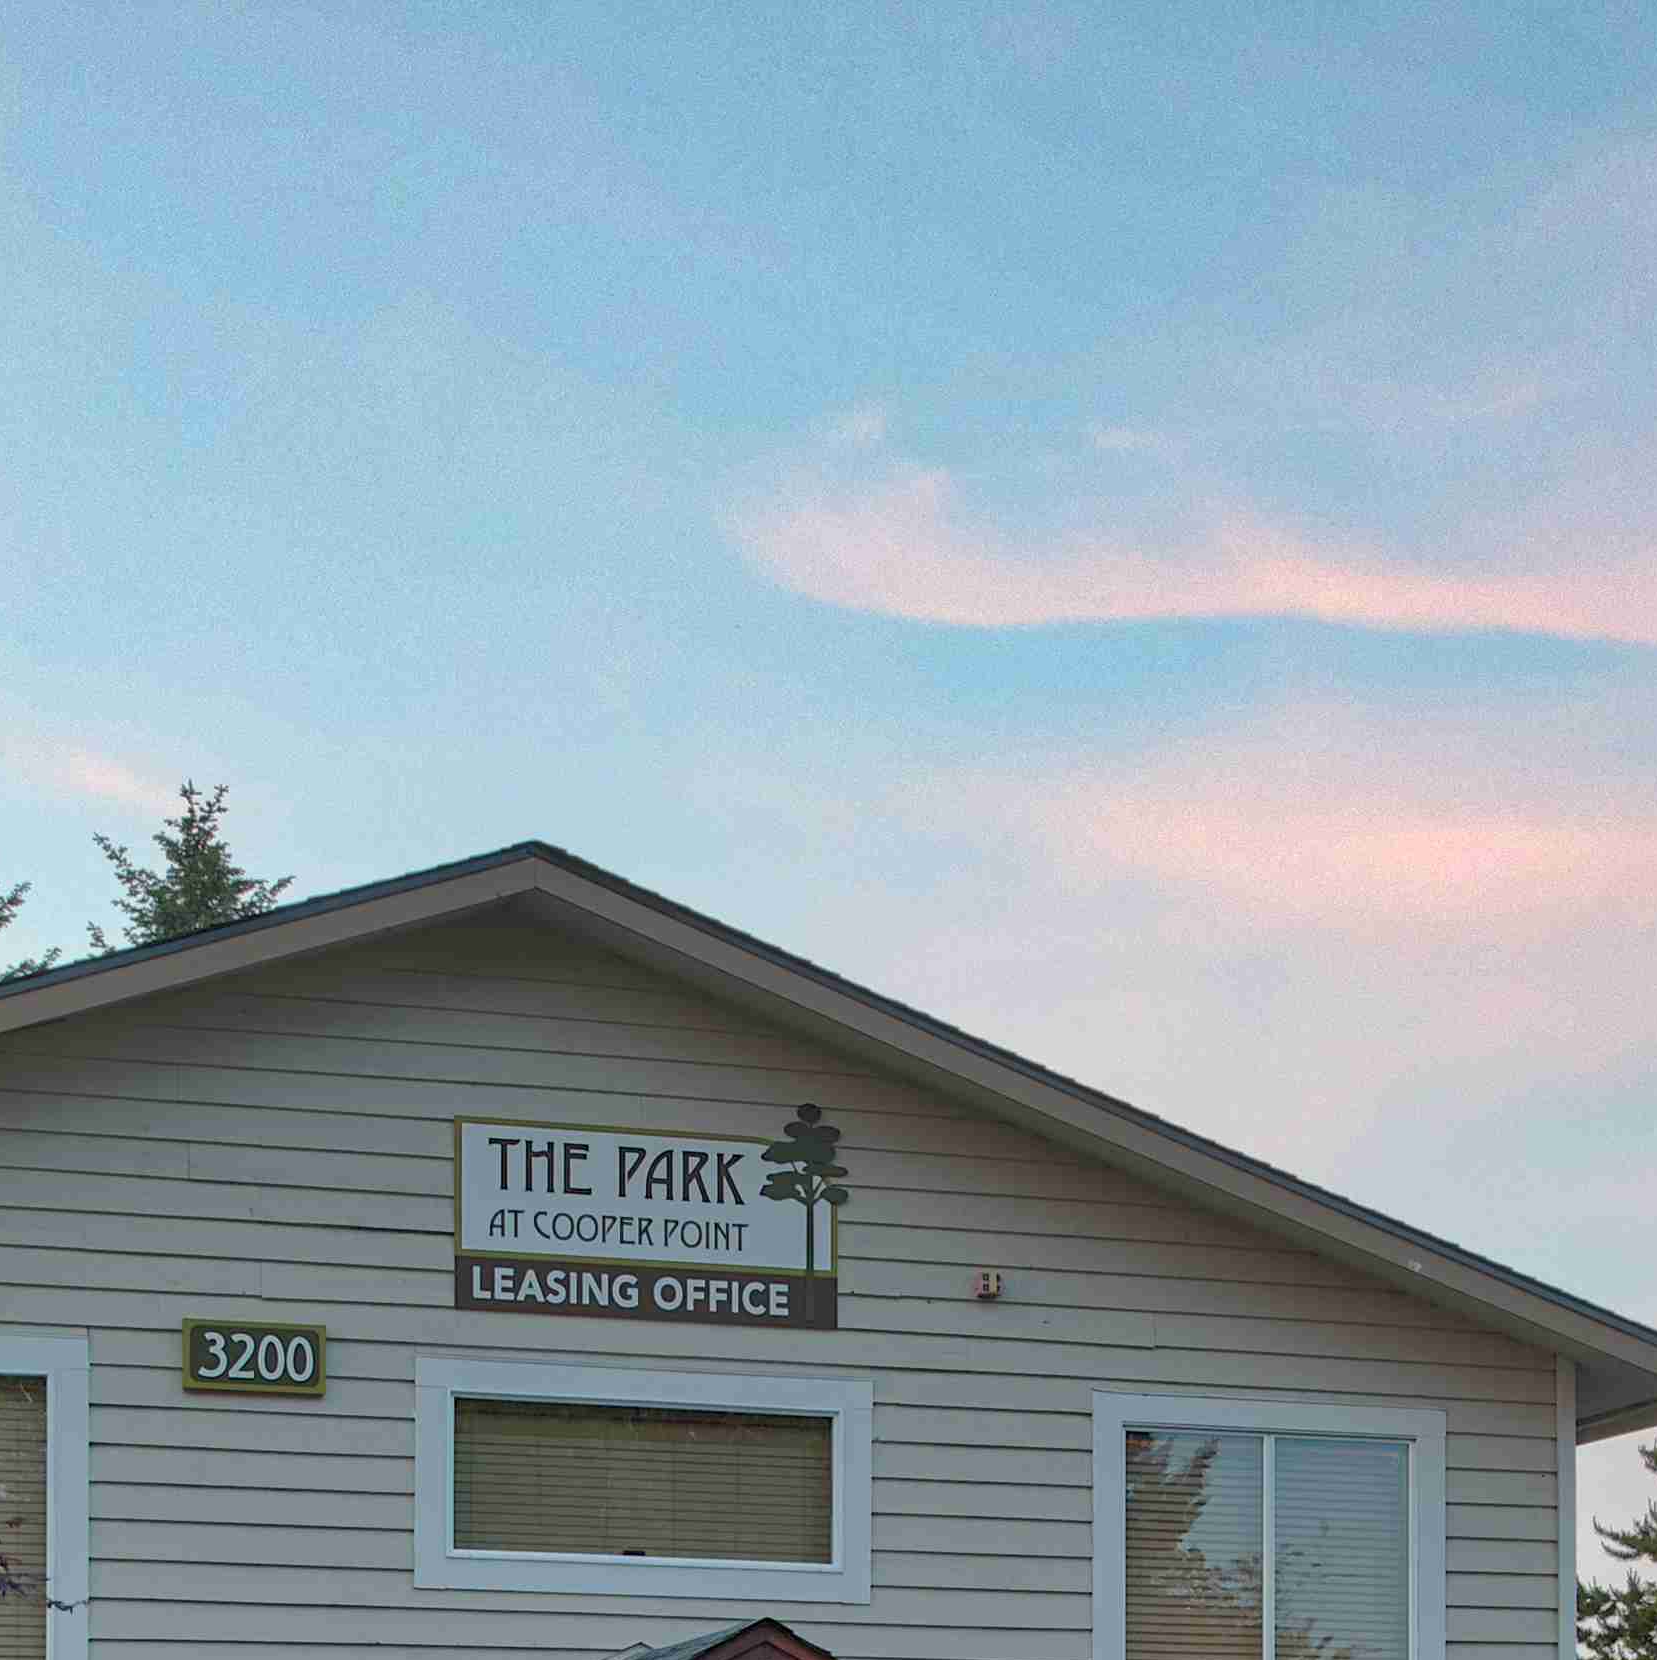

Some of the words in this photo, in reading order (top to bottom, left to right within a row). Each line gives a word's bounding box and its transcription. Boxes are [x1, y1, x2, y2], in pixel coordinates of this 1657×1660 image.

[488, 1137, 592, 1196] THE
[617, 1145, 746, 1206] PARK
[488, 1208, 524, 1238] AT
[532, 1210, 654, 1247] COOPER
[662, 1216, 749, 1253] POINT
[471, 1263, 639, 1310] LEASING
[652, 1276, 790, 1318] OFFICE
[196, 1330, 315, 1383] 3200
